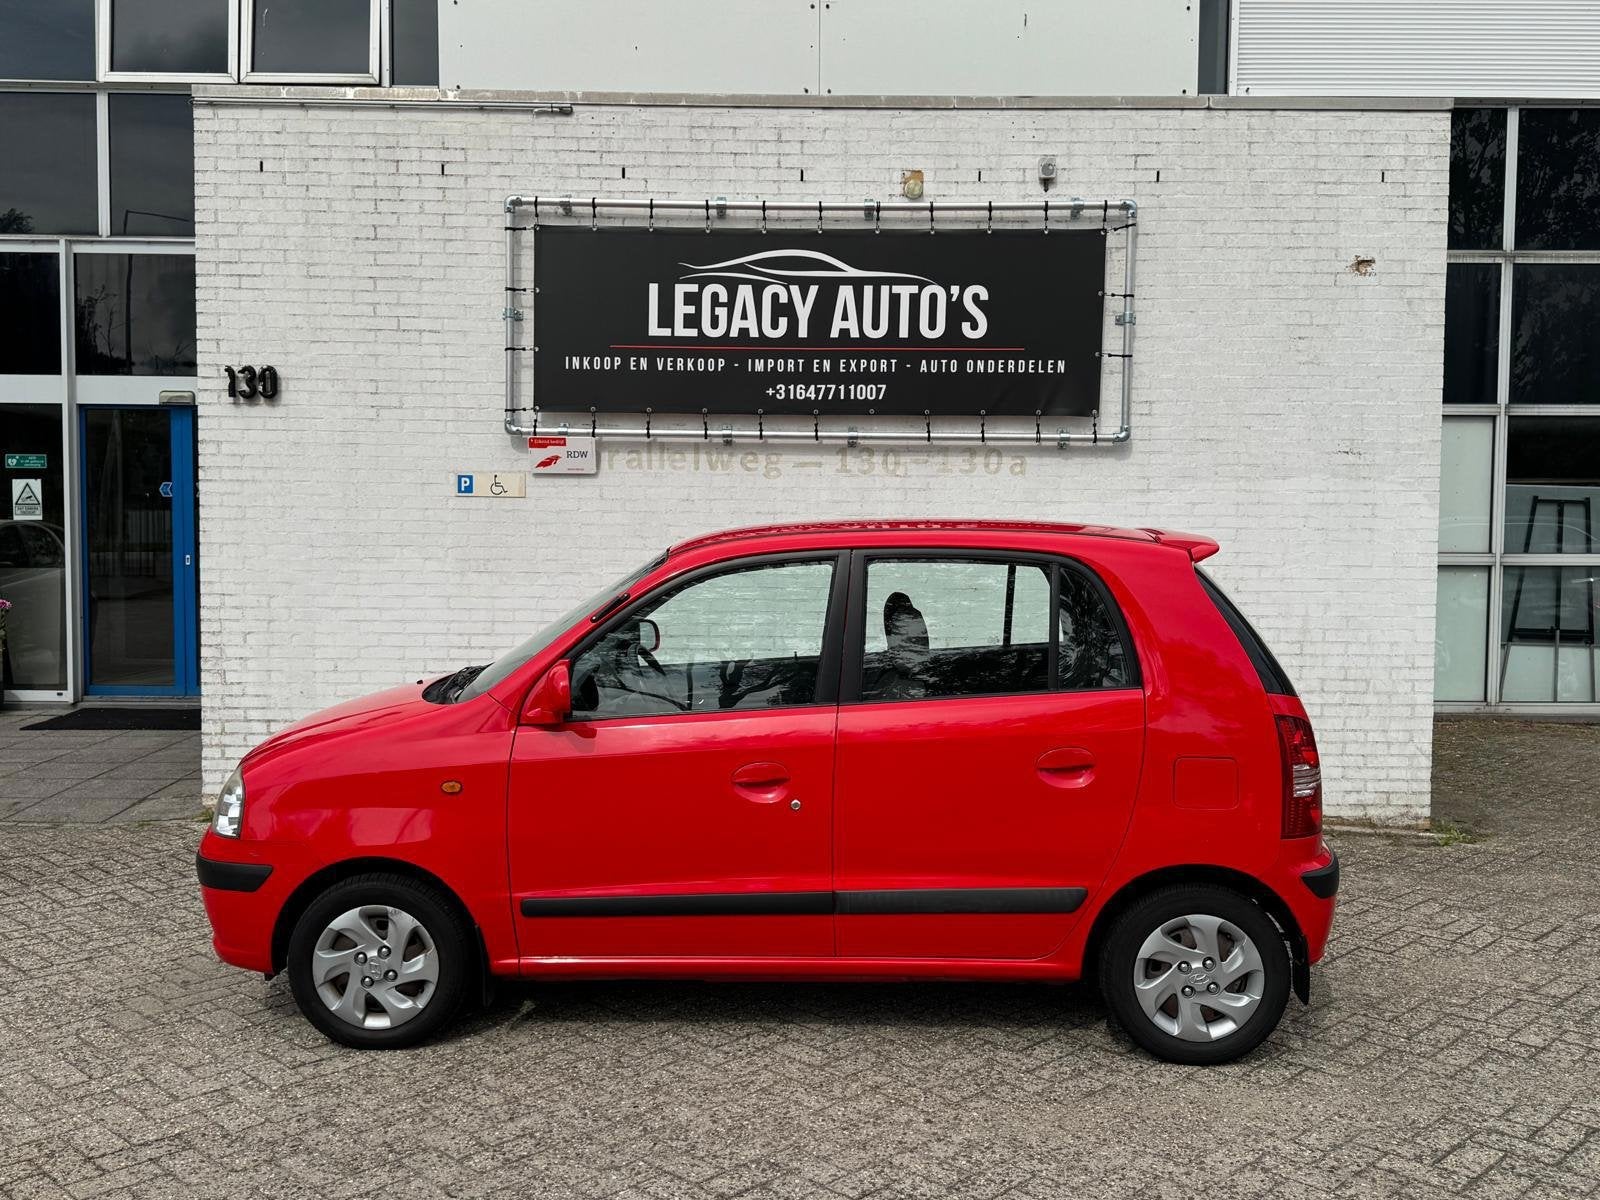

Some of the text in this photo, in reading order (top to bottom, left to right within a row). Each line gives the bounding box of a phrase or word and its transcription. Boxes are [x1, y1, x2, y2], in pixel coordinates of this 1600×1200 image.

[648, 283, 989, 339] LEGACY AUTO'S
[565, 356, 622, 370] INKOOP
[630, 356, 648, 371] EN
[656, 357, 726, 372] VERKOOP
[747, 358, 805, 373] IMPORT
[813, 359, 831, 373] EN
[839, 359, 898, 373] EXPORT
[919, 359, 958, 373] AUTO
[966, 359, 1066, 374] ONDERDELEN
[224, 365, 278, 399] 130
[765, 383, 887, 401] +31647711007
[566, 450, 588, 459] RDW
[460, 478, 470, 491] P
